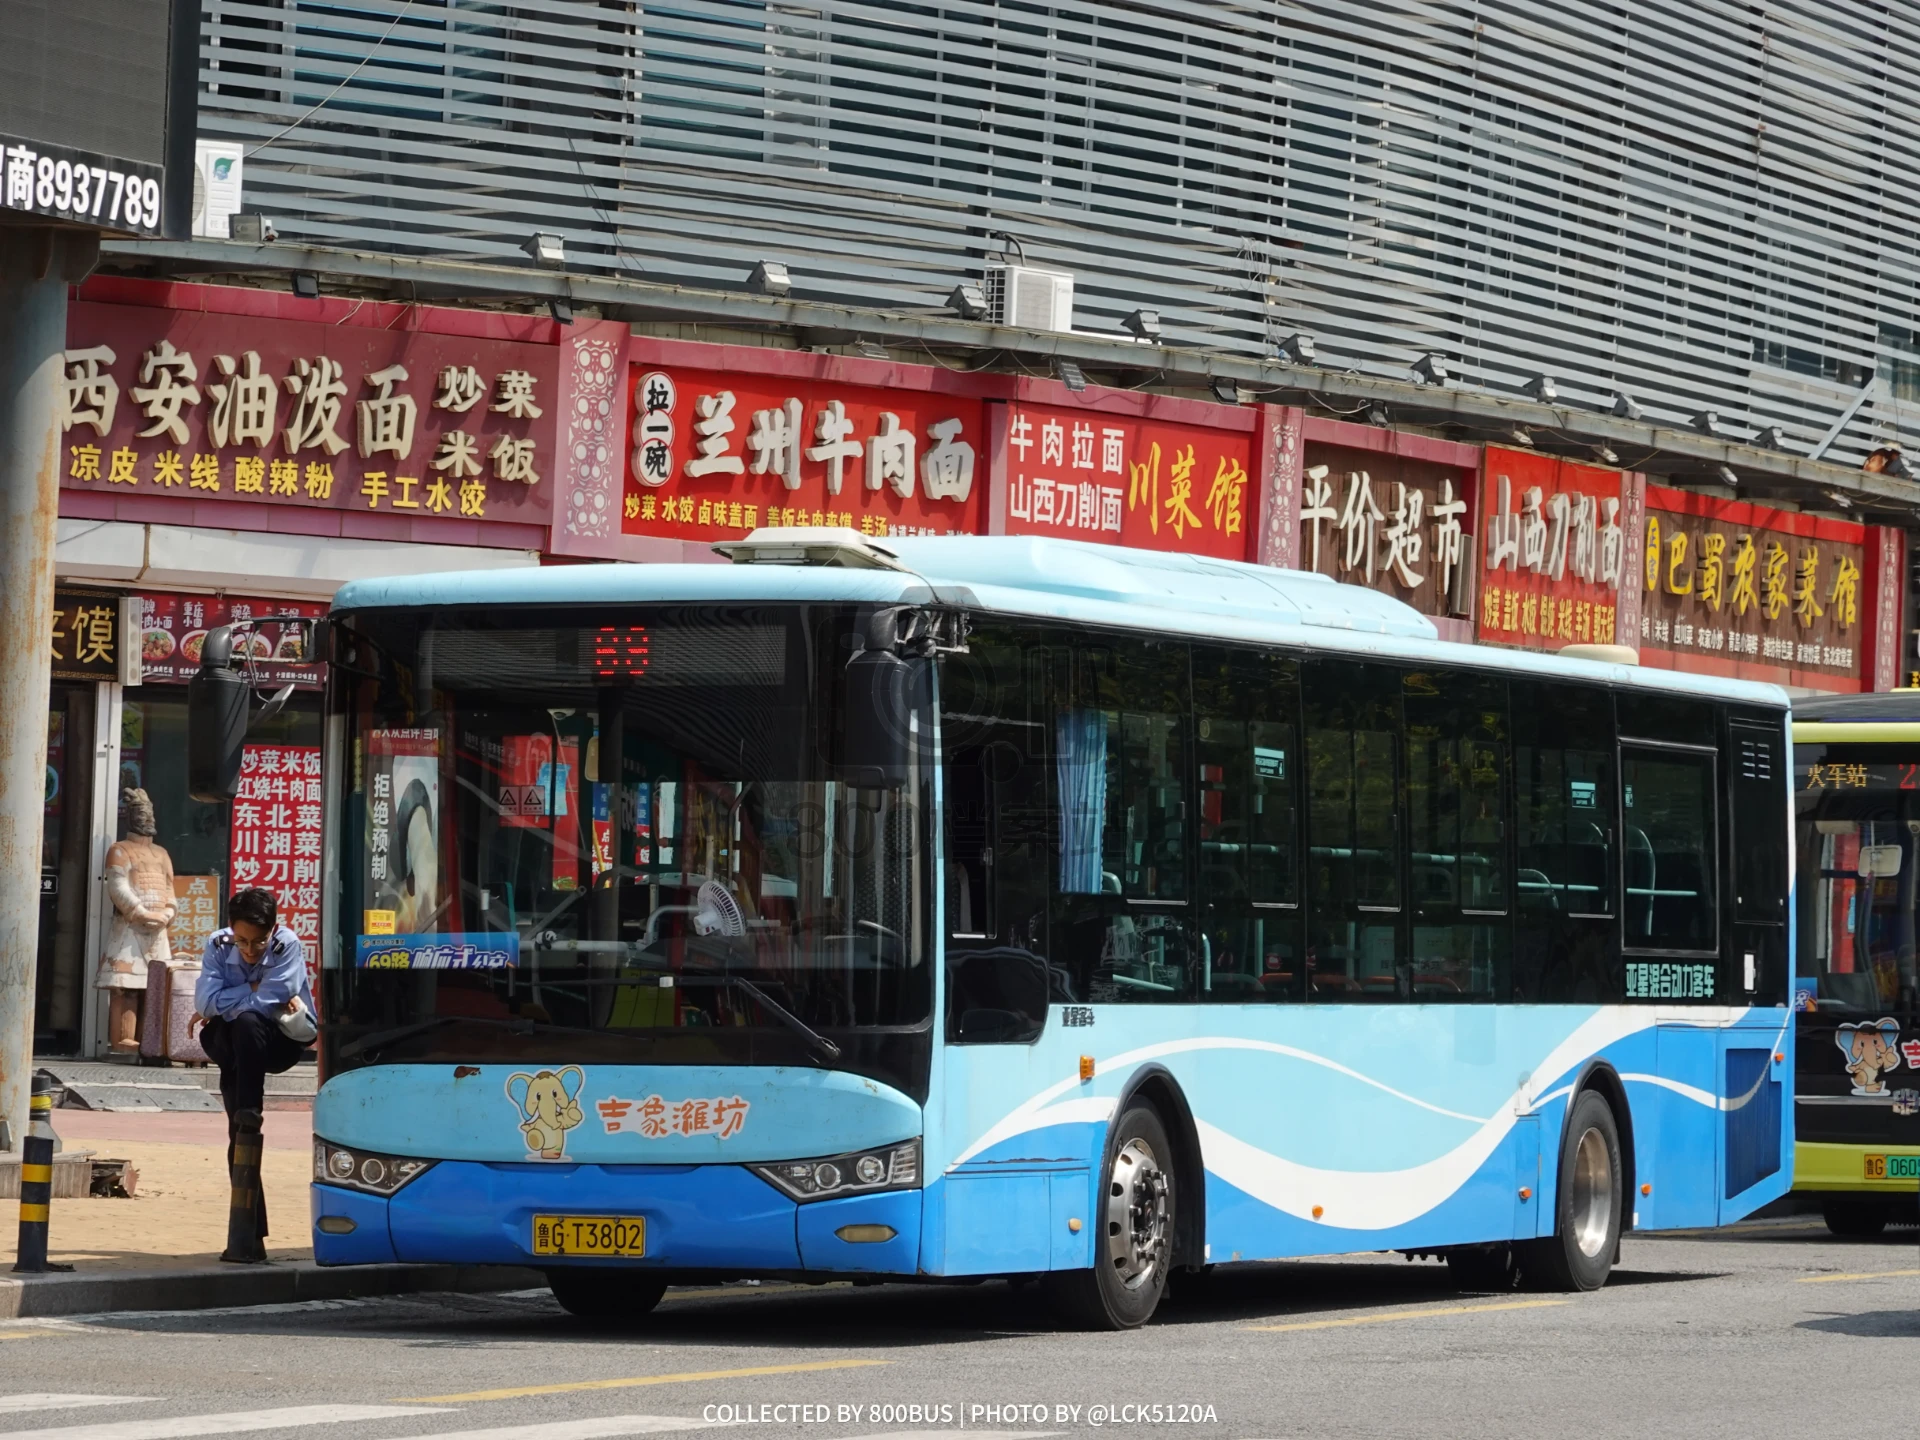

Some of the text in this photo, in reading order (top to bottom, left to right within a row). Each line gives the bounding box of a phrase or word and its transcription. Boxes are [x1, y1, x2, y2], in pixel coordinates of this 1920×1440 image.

[0, 144, 160, 229] 商8937789
[62, 339, 418, 461] 西安油泼面
[433, 365, 543, 418] 炒菜
[645, 379, 669, 478] 拉一碗
[683, 390, 976, 503] 兰州牛肉面
[1010, 414, 1124, 475] 牛肉拉面
[70, 443, 487, 517] 凉皮 米线 酸辣粉 手工水饺
[429, 430, 541, 484] 米饭
[625, 493, 656, 521] 炒菜
[661, 496, 694, 523] 水饺
[698, 499, 758, 530] 卤味盖面
[861, 515, 887, 536] 羊汤
[1010, 474, 1124, 533] 山西刀削面
[1129, 441, 1248, 539] 川菜馆
[1300, 464, 1467, 596] 平价超市
[1488, 474, 1623, 590] 山西刀削面
[1666, 531, 1860, 629] 巴蜀农家菜馆
[141, 615, 173, 629] 肉小面
[1484, 585, 1500, 630] 炒菜
[1558, 598, 1572, 641] 米线
[235, 776, 321, 802] 红烧牛肉面
[241, 748, 321, 776] 炒菜米饭
[1807, 764, 1867, 789] 火车站
[234, 802, 321, 829] 东北菜
[234, 830, 320, 856] 川湘菜
[371, 773, 391, 880] 拒绝预制
[233, 857, 320, 883] 炒刀削
[235, 883, 319, 909] 水饺
[1626, 963, 1715, 998] 亚星混合动力客车
[1867, 1159, 1920, 1177] 鲁G060
